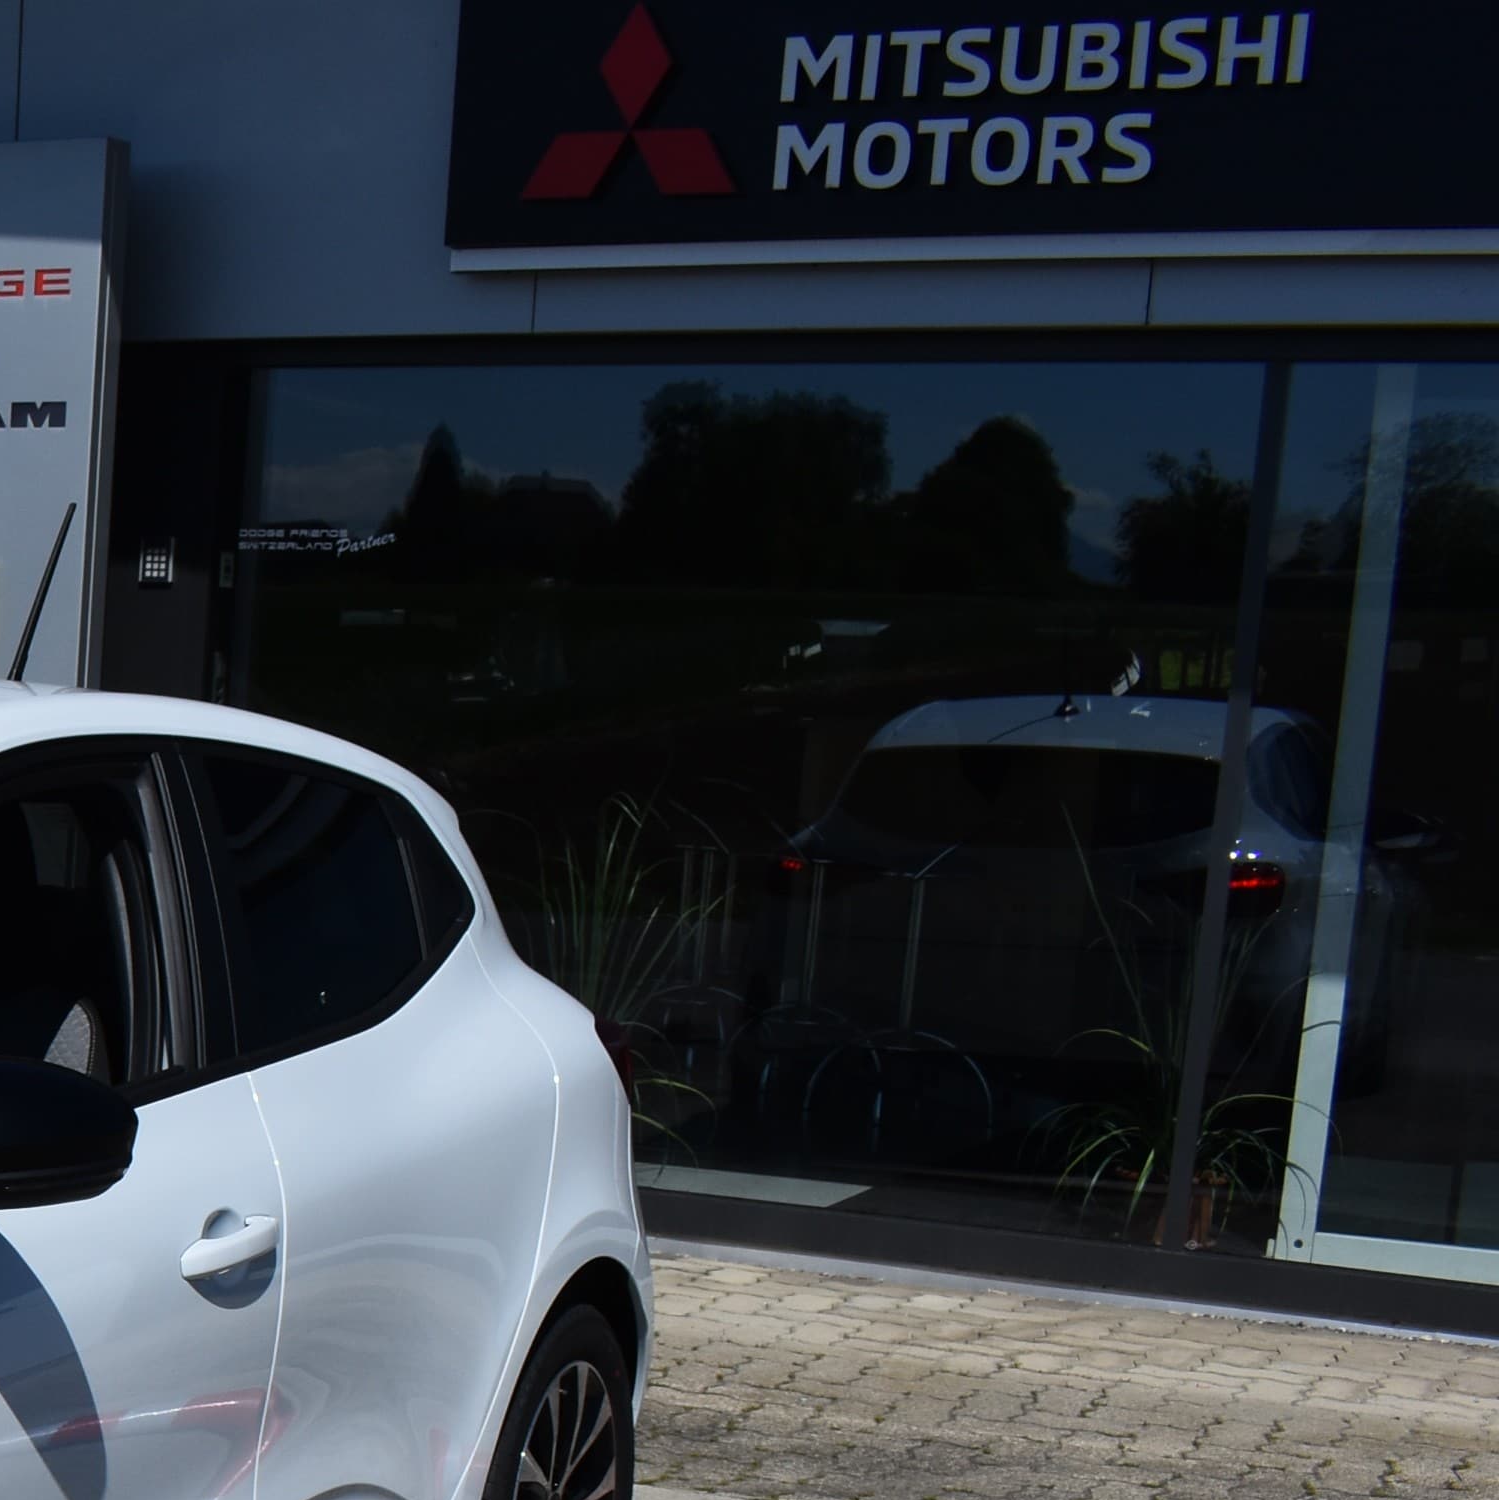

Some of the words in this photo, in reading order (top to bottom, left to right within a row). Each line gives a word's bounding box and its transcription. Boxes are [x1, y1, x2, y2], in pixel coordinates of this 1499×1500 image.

[779, 12, 1310, 104] MITSUBISHI
[772, 112, 1155, 192] MOTORS
[238, 529, 285, 538] DODGE
[238, 541, 333, 550] SWITZERLAND
[335, 533, 396, 557] Partner
